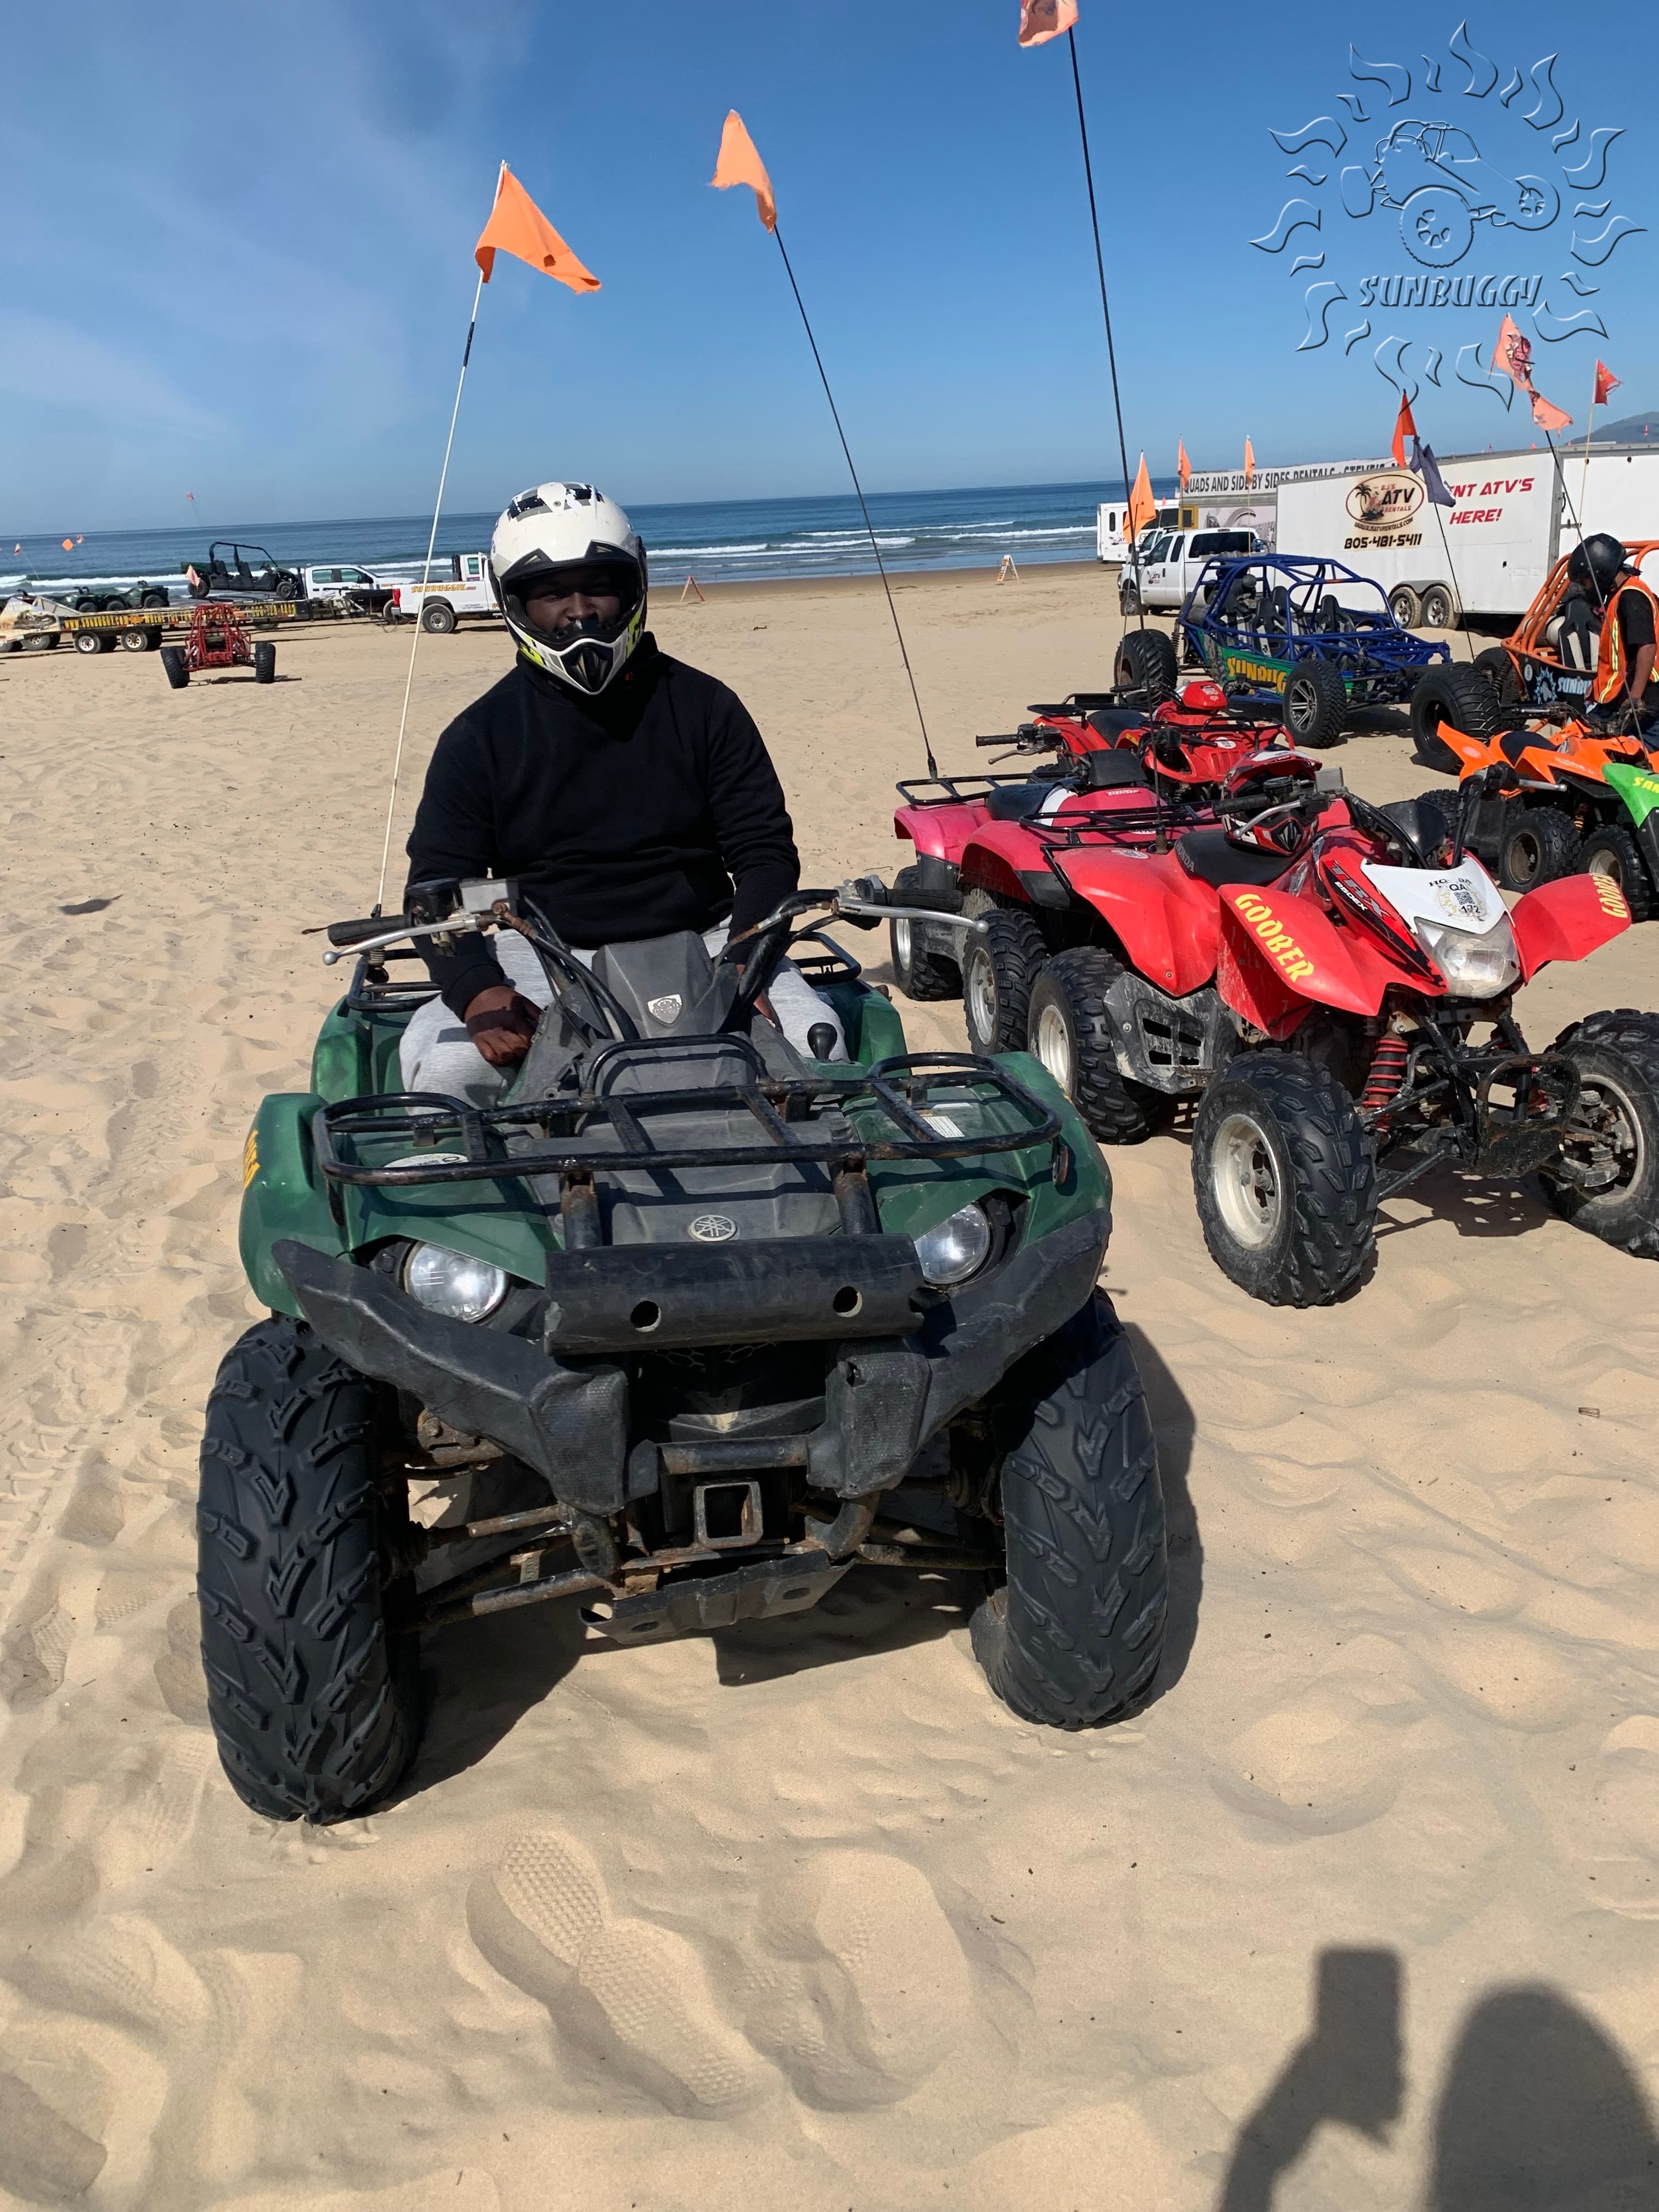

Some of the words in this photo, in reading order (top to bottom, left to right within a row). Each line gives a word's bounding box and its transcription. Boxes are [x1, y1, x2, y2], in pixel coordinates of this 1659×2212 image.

[1211, 476, 1229, 492] AND
[1252, 473, 1263, 489] BY
[1479, 477, 1535, 495] ATV'S
[1381, 488, 1415, 505] ATV
[1449, 508, 1503, 524] HERE!
[1344, 533, 1423, 549] 805-481-5411
[1175, 840, 1194, 872] HONDA
[1330, 860, 1396, 922] TRX
[1235, 894, 1314, 983] GOOBER
